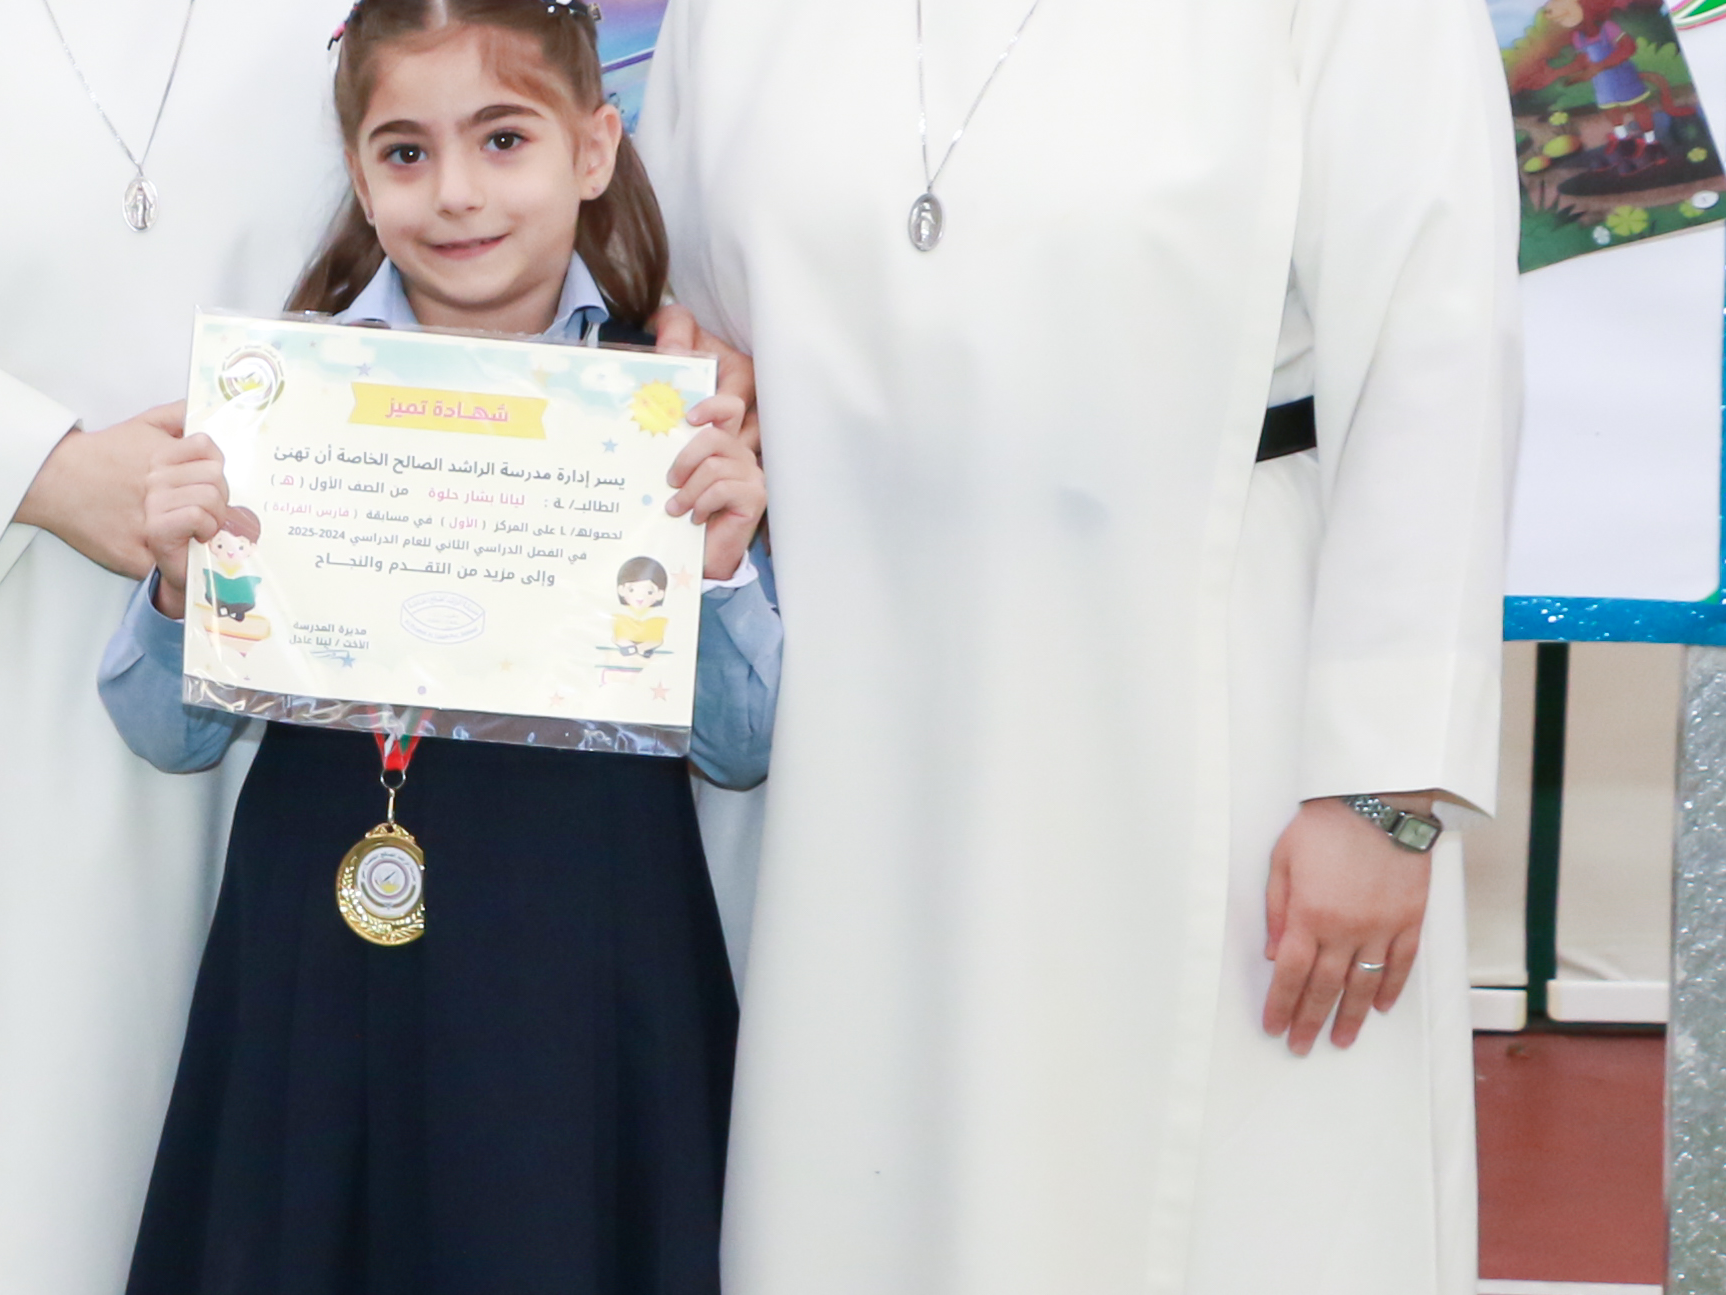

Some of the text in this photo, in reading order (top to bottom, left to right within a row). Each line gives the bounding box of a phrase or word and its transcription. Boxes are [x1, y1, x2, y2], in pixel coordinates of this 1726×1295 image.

[385, 397, 429, 419] تميز
[314, 444, 332, 465] أن
[336, 447, 389, 467] الخاصة
[393, 456, 442, 474] الصالح
[448, 460, 495, 478] الراشد
[500, 462, 552, 482] مدرسة
[309, 476, 343, 491] الأول
[556, 467, 590, 489] إدارة
[594, 472, 626, 491] يسر
[347, 480, 385, 494] الصف
[389, 485, 409, 498] من
[428, 486, 459, 502] حلوة
[464, 489, 494, 505] بشار
[272, 503, 311, 515] القراءة
[316, 507, 349, 519] فارس
[366, 510, 409, 523] مسابقة
[413, 516, 433, 529] في
[448, 516, 478, 530] الأول
[493, 519, 528, 534] المركز
[532, 525, 555, 537] على
[349, 532, 398, 547] الدراسي
[402, 535, 431, 550] للعام
[435, 540, 469, 553] الثاني
[473, 544, 522, 557] الدراسي
[526, 548, 563, 559] الفصل
[568, 551, 587, 565] في
[457, 566, 478, 580] من
[483, 569, 515, 582] مزيد
[521, 570, 555, 587] وإلى
[293, 621, 367, 637] مديرة المدرسة
